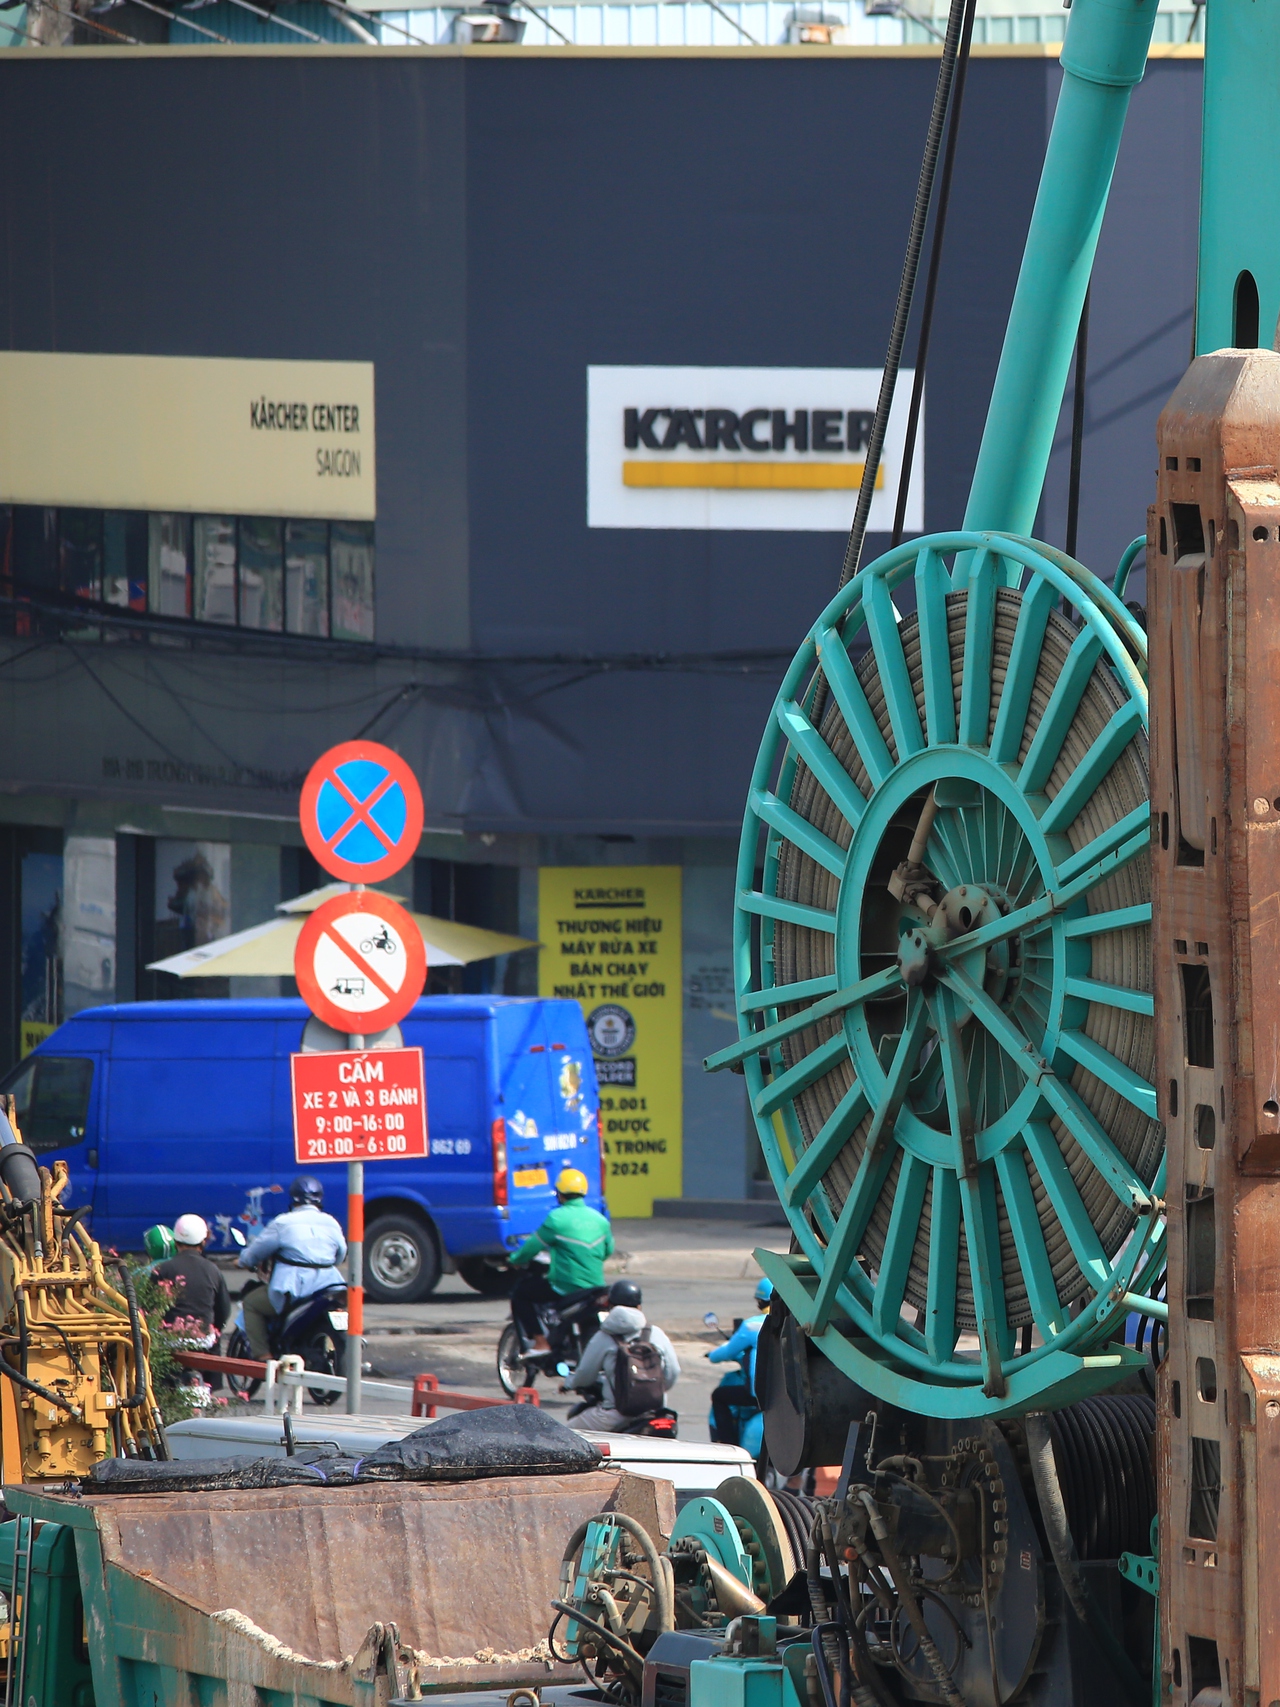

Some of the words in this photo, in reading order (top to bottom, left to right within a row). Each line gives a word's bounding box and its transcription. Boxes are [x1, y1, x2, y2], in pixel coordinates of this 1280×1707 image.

[312, 403, 360, 433] CENTER
[316, 447, 361, 477] SAIGON
[557, 919, 622, 934] THƯƠNG
[626, 916, 662, 937] HIỆU
[638, 940, 658, 955] XE
[570, 959, 603, 977] BÁN
[553, 981, 596, 998] NHẤT
[338, 1053, 384, 1083] CẤM
[303, 1092, 324, 1109] XE
[328, 1090, 338, 1108] 2
[342, 1086, 361, 1107] VÀ
[365, 1090, 375, 1107] 3
[379, 1083, 418, 1106] BÁNH
[615, 1140, 667, 1155] TRONG
[611, 1162, 649, 1176] 2024
